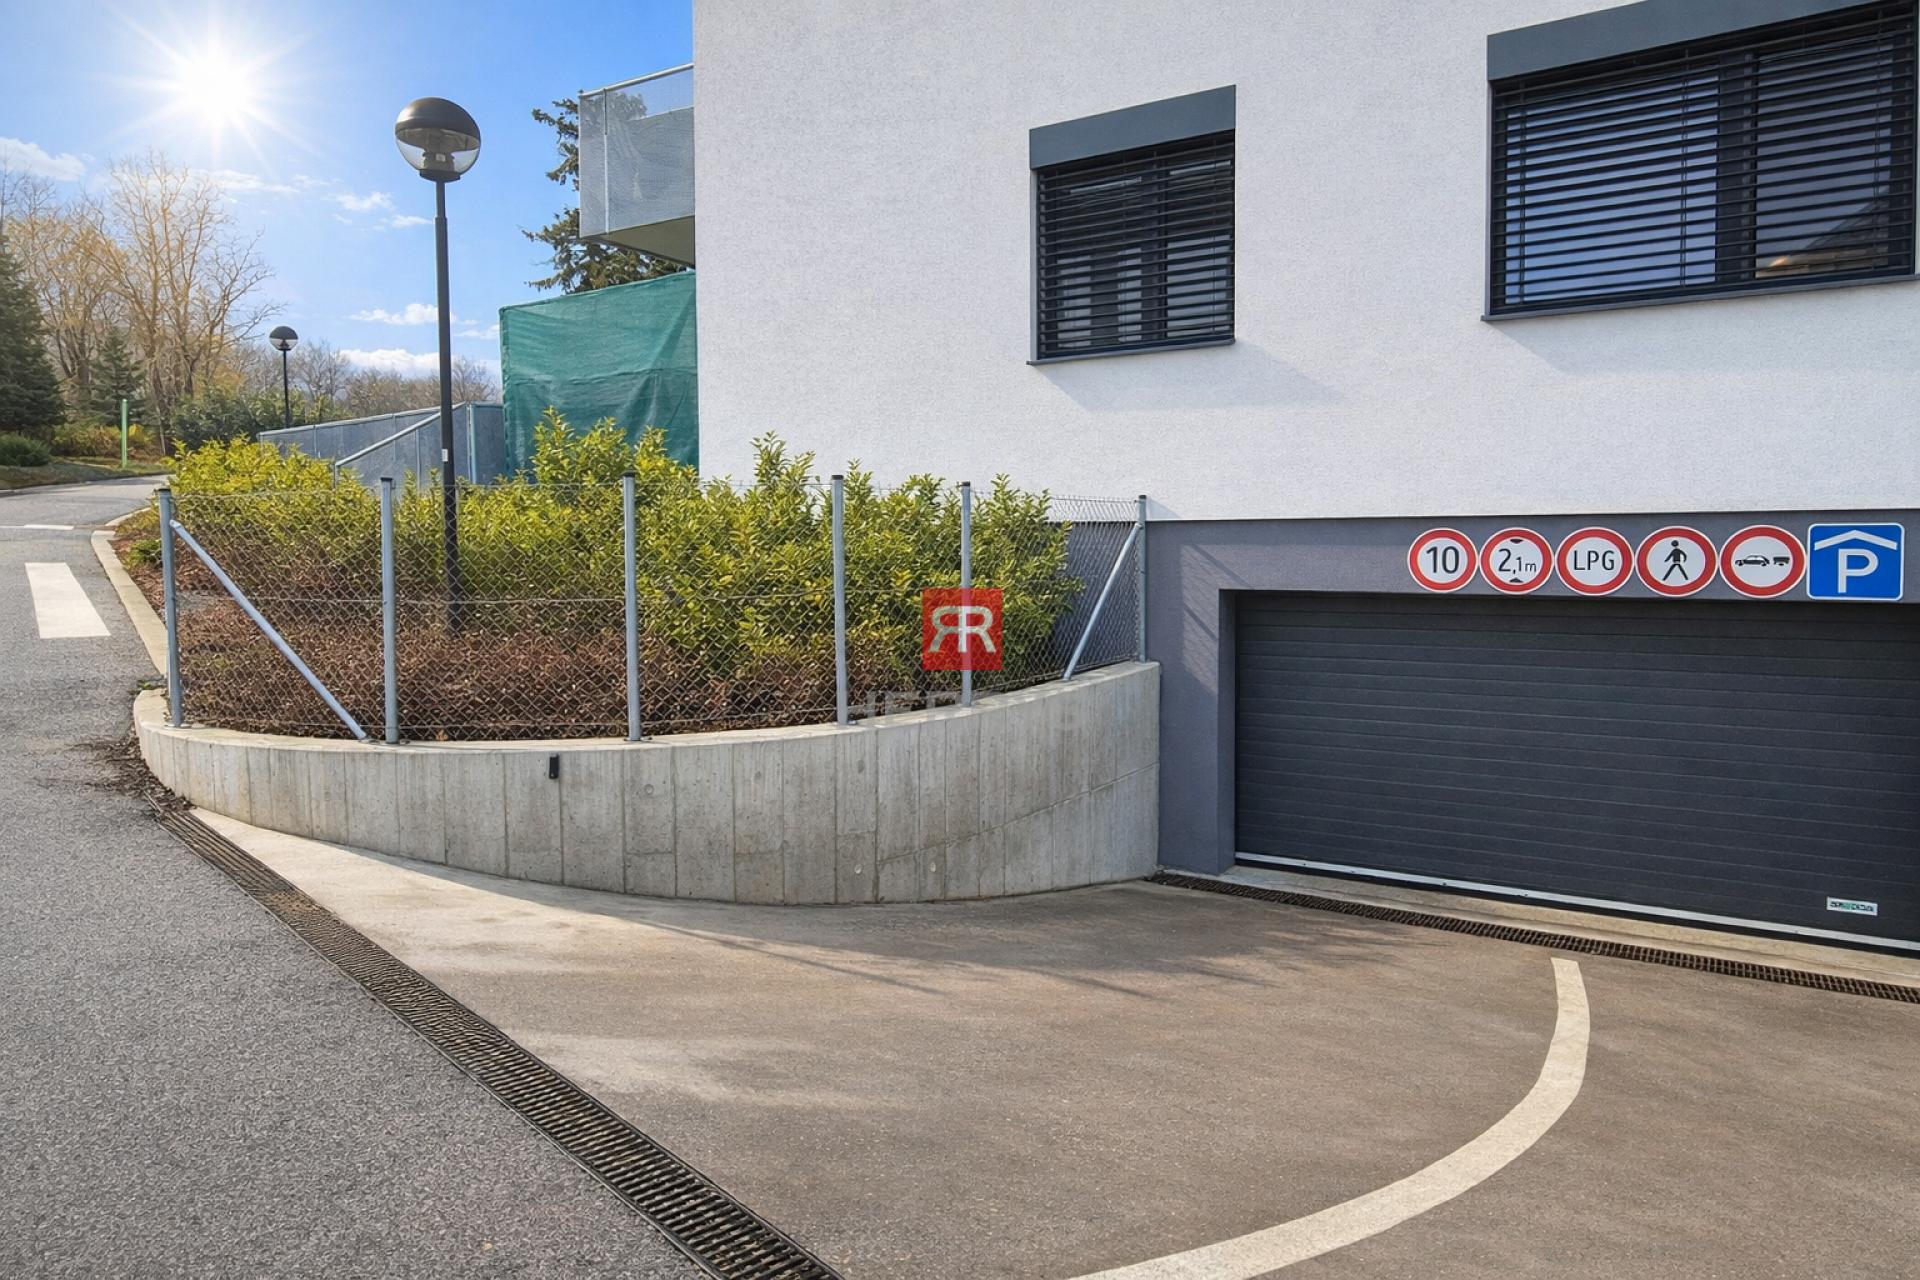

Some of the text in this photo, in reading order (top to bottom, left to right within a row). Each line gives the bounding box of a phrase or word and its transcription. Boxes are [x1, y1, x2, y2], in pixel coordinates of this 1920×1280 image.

[1426, 545, 1460, 574] 10
[1573, 550, 1615, 571] LPG
[1838, 548, 1879, 593] P
